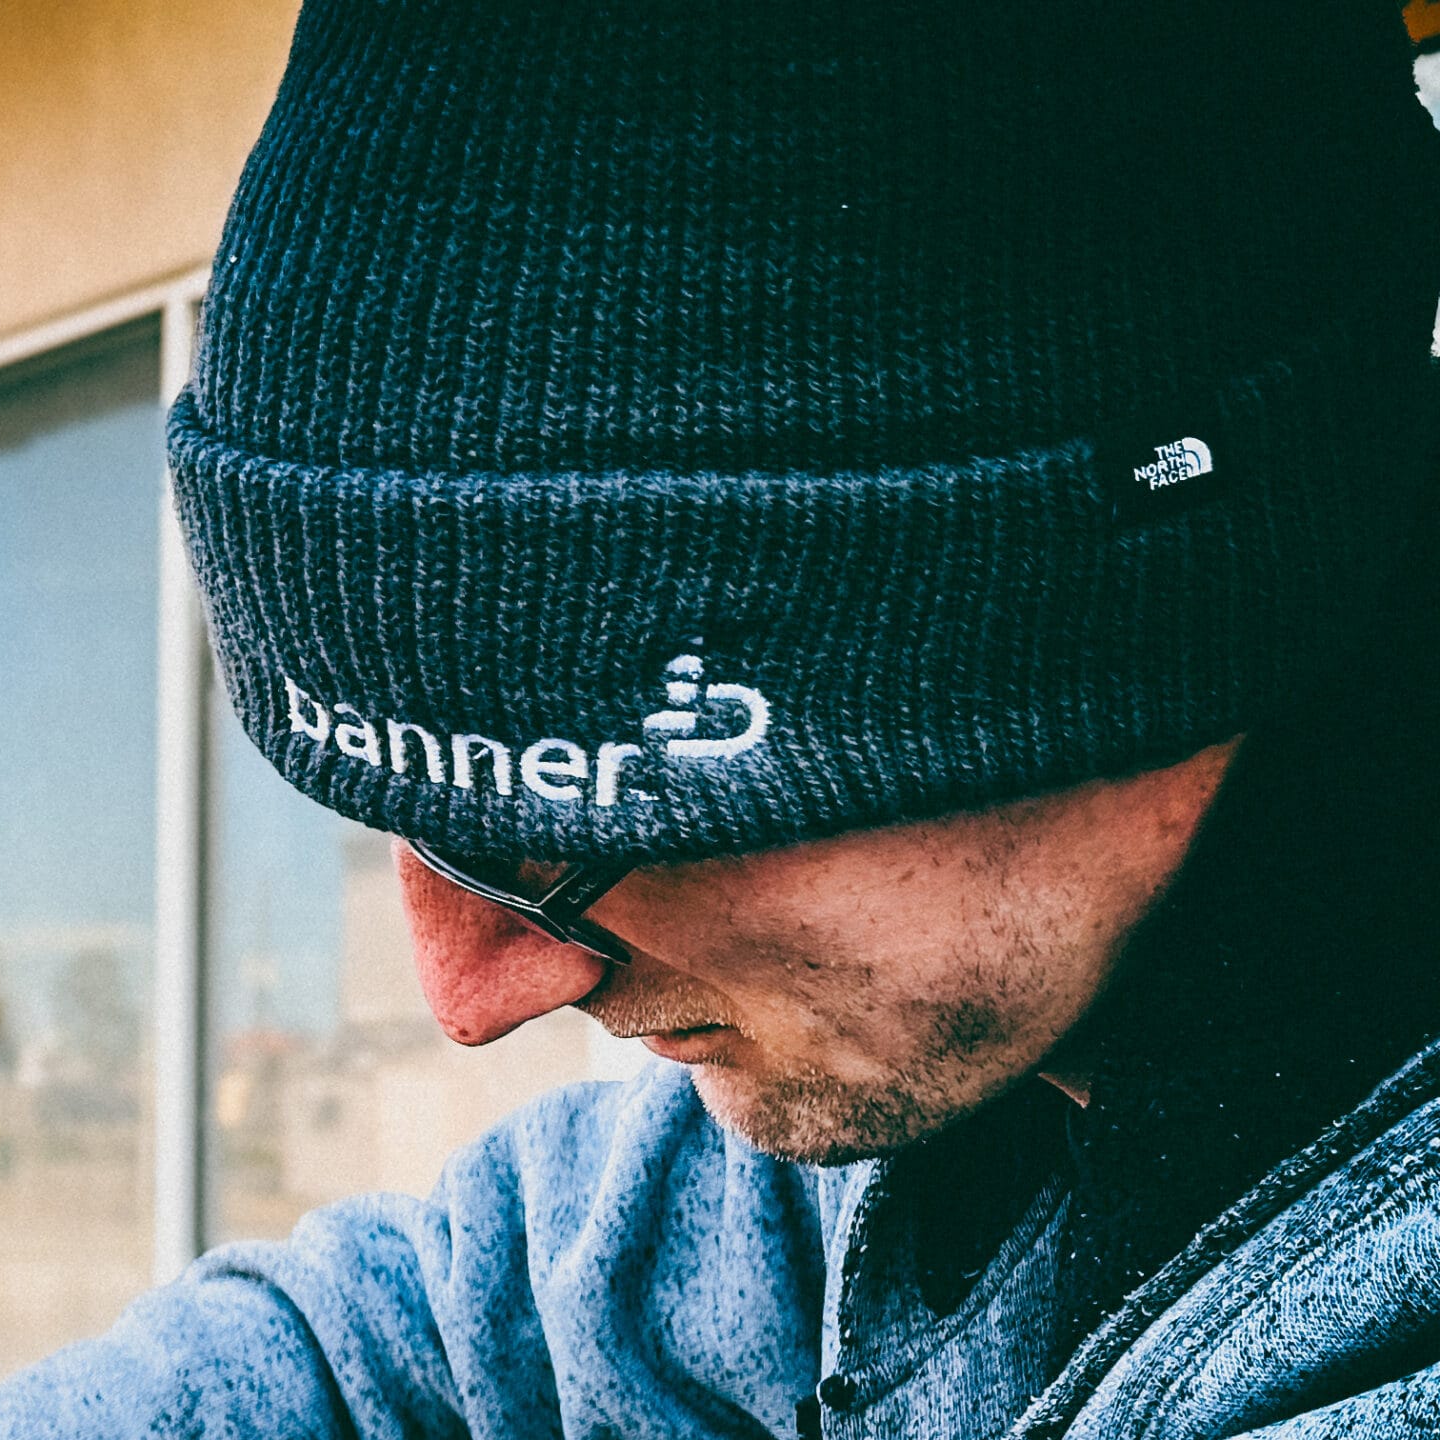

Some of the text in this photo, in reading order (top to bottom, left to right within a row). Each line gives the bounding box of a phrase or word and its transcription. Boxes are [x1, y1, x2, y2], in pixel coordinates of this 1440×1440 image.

[1154, 441, 1183, 459] THE
[1133, 454, 1185, 481] NORTH
[1149, 467, 1187, 490] FACE
[283, 675, 641, 806] banner
